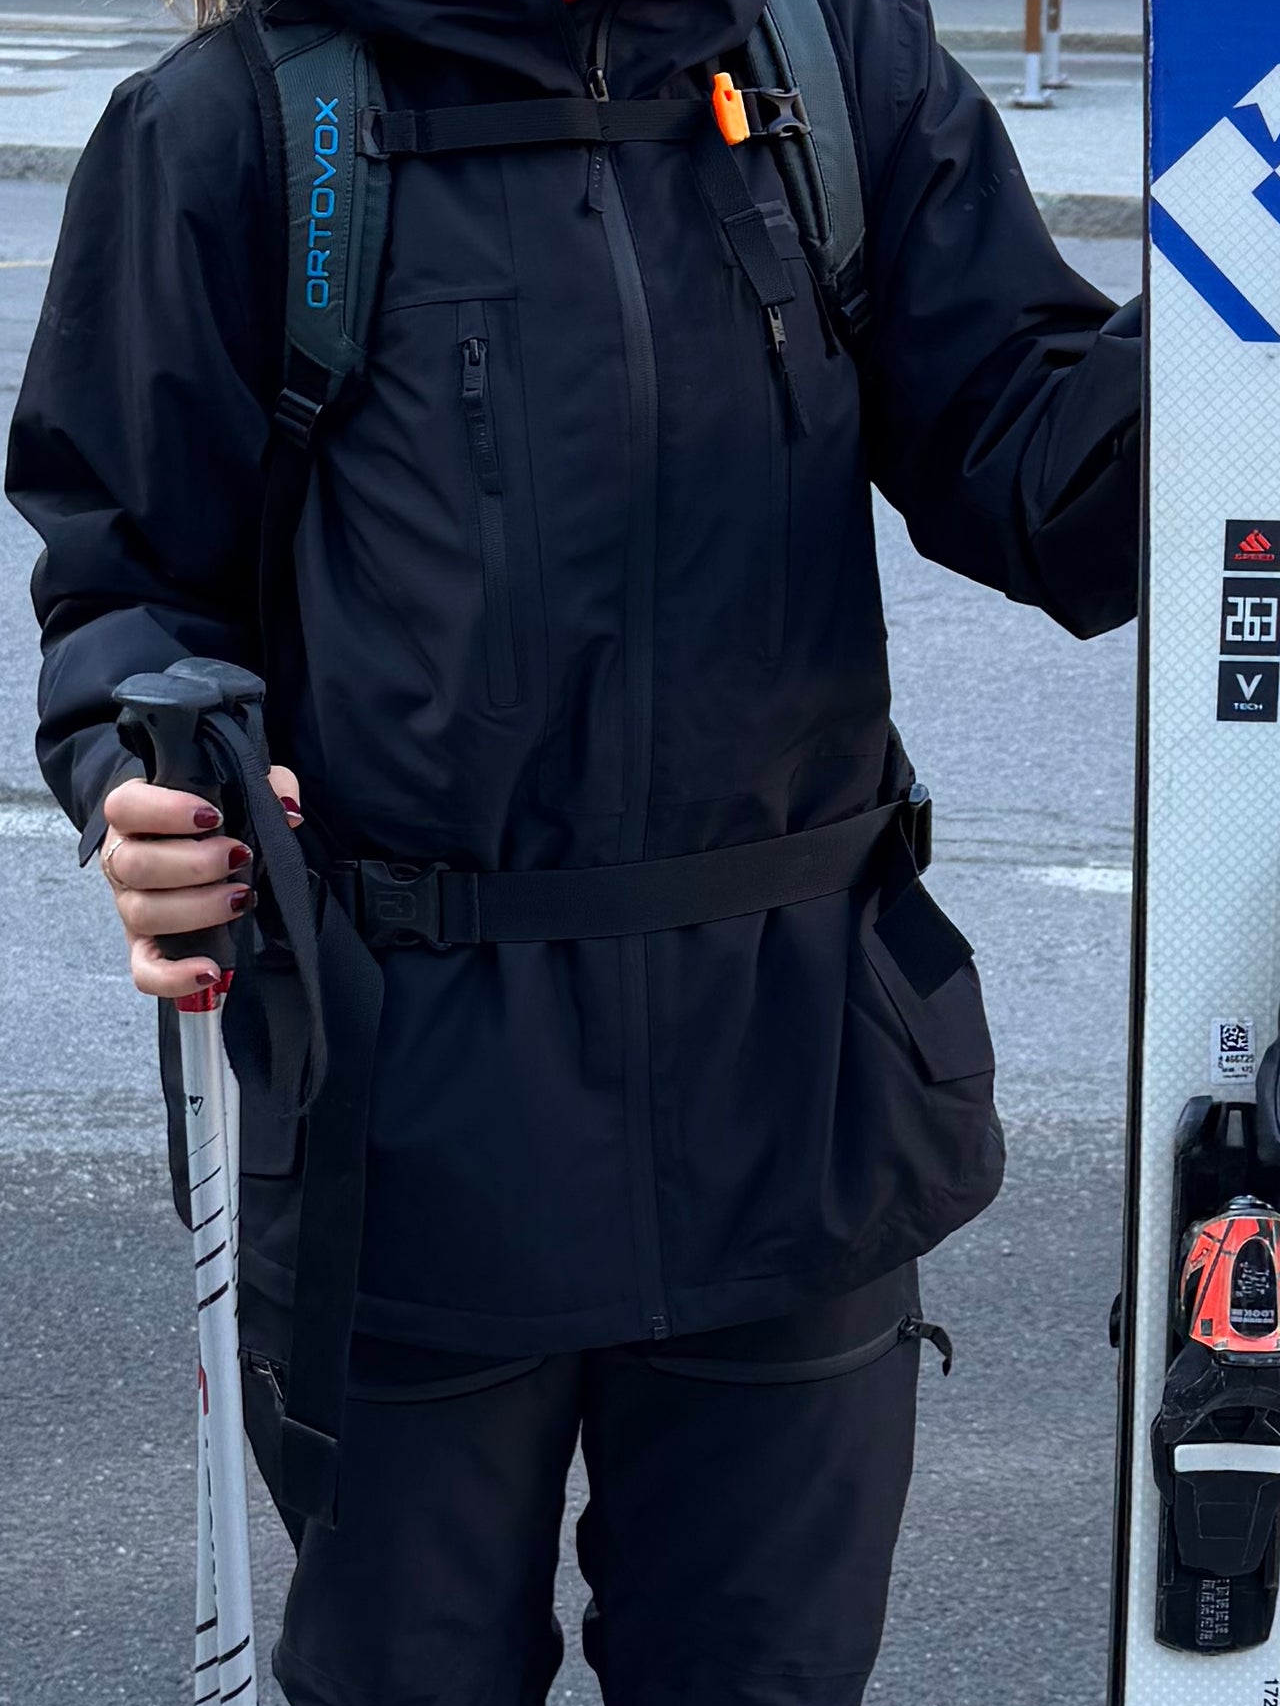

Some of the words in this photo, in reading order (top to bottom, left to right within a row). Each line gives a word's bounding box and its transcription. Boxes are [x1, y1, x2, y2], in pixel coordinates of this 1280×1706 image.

[305, 96, 339, 309] ORTOVOX
[1225, 596, 1278, 642] 263
[1233, 702, 1263, 711] TECH
